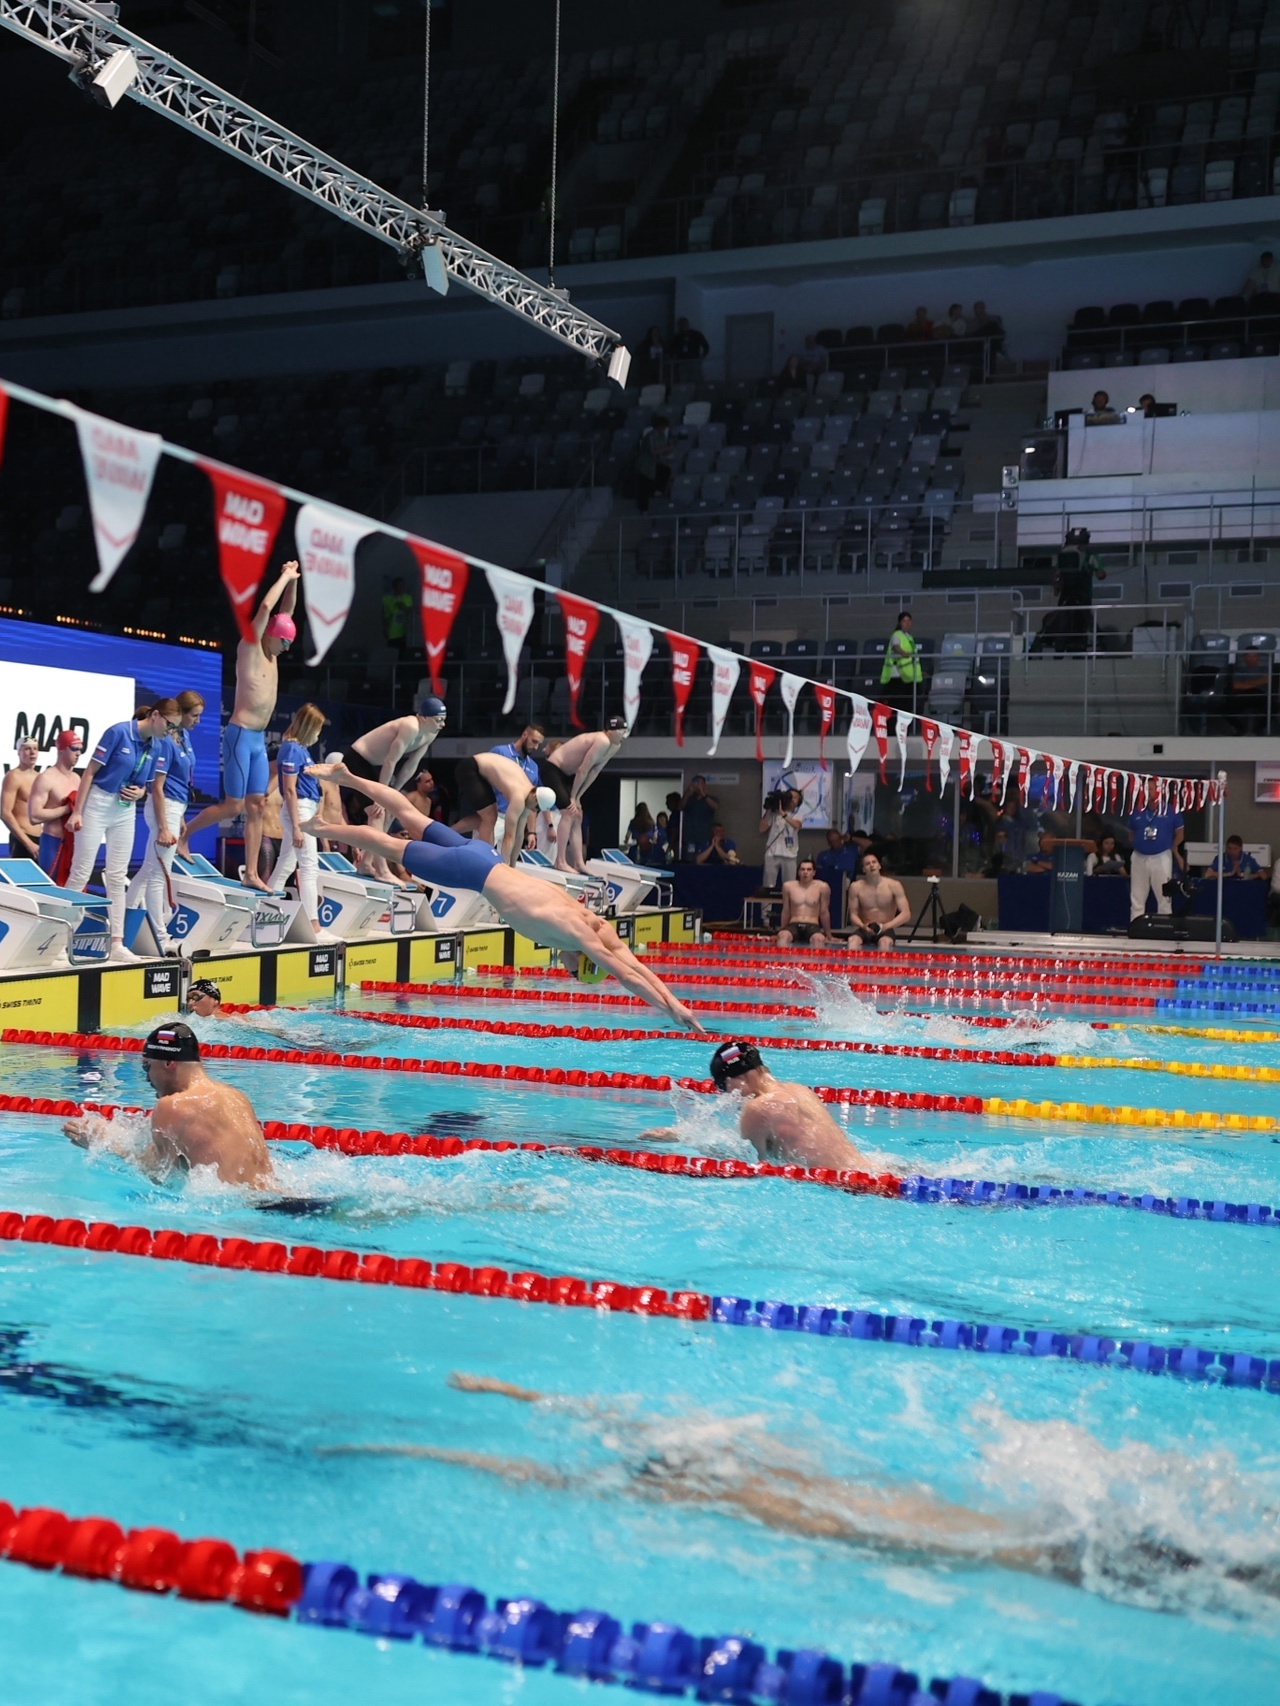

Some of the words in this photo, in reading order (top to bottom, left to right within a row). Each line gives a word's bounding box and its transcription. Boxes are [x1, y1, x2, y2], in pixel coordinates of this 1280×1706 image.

[223, 491, 264, 526] MAD
[606, 887, 615, 899] 9
[321, 904, 333, 923] 6
[437, 897, 447, 915] 7
[176, 912, 189, 935] 5
[219, 921, 239, 942] 5
[36, 932, 58, 956] 4
[152, 972, 171, 983] MAD
[151, 982, 171, 994] WAVE
